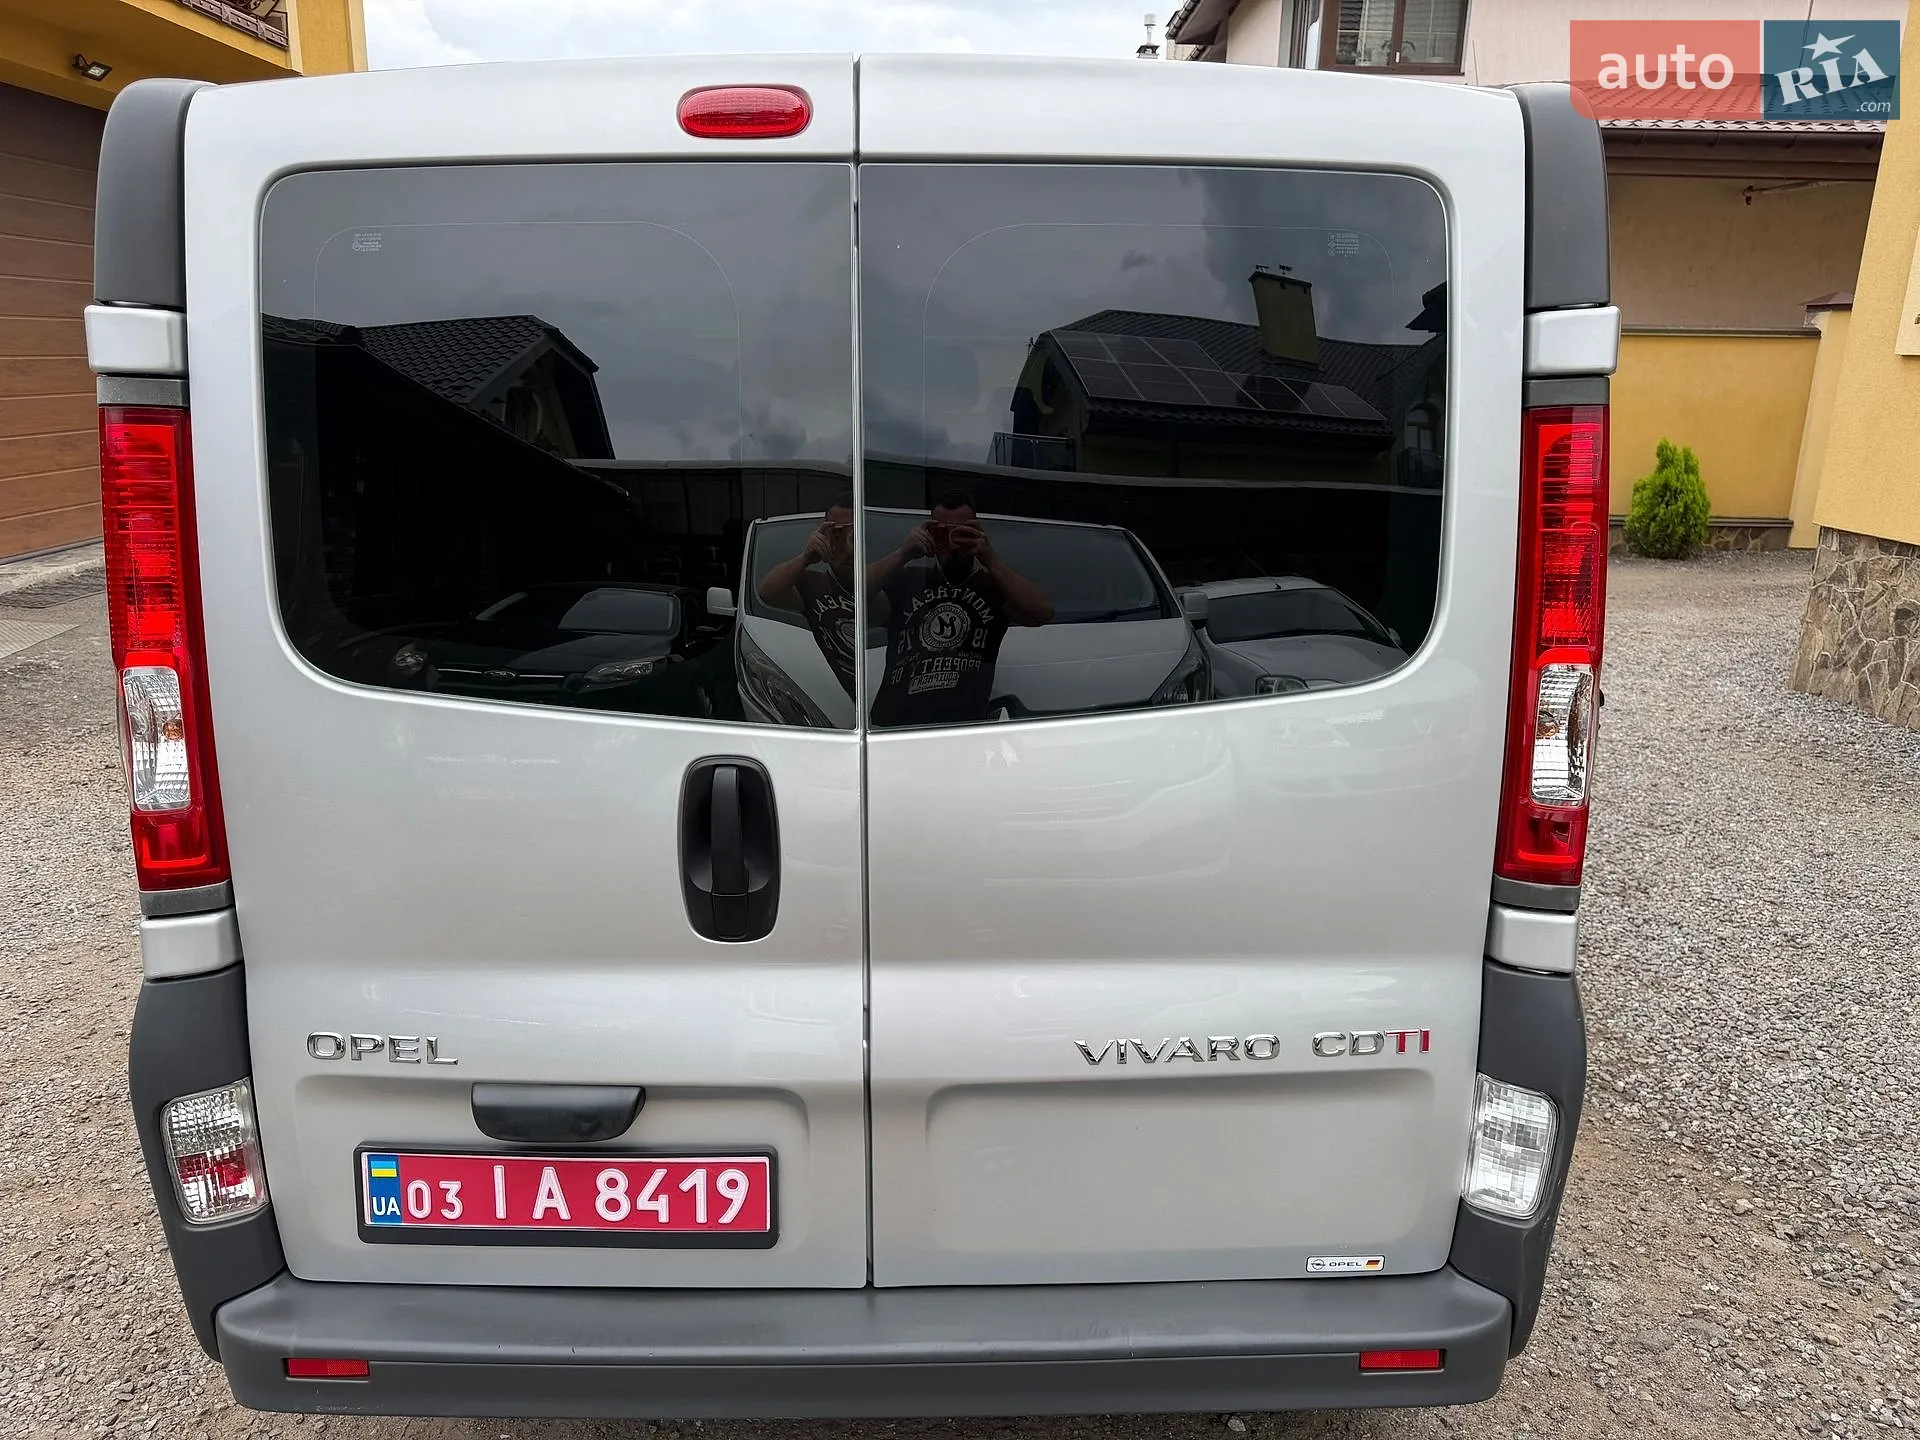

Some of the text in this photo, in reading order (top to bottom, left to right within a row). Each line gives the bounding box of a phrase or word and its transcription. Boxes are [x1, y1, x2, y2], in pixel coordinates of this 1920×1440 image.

[307, 1031, 458, 1065] OPEL
[1074, 1026, 1431, 1066] VIVARO CDTI
[372, 1196, 401, 1217] UA
[407, 1180, 463, 1220] 03
[595, 1168, 750, 1224] 8419
